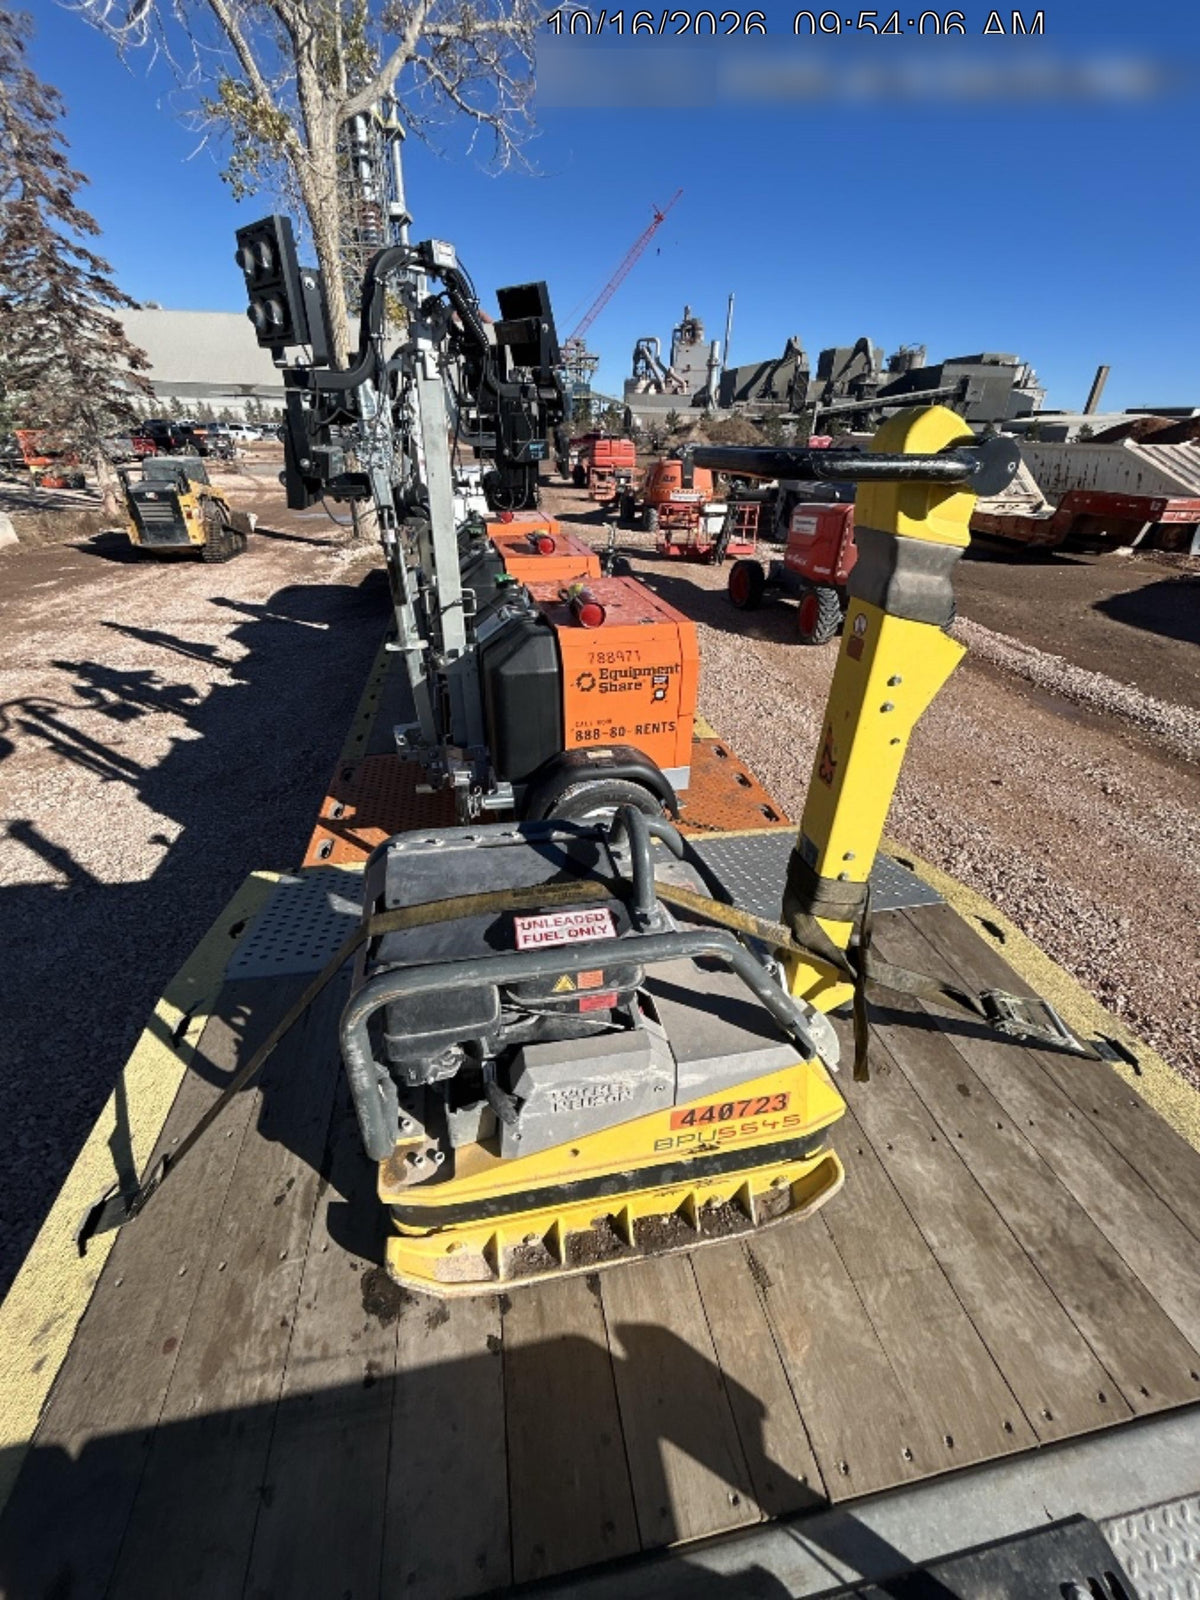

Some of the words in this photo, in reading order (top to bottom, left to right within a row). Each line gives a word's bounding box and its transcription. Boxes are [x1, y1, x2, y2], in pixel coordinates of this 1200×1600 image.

[598, 662, 681, 681] Equipment
[598, 681, 643, 694] Share
[520, 912, 606, 931] UNLEADED
[523, 931, 564, 945] FUEL
[568, 924, 608, 939] ONLY
[680, 1092, 788, 1127] 440723
